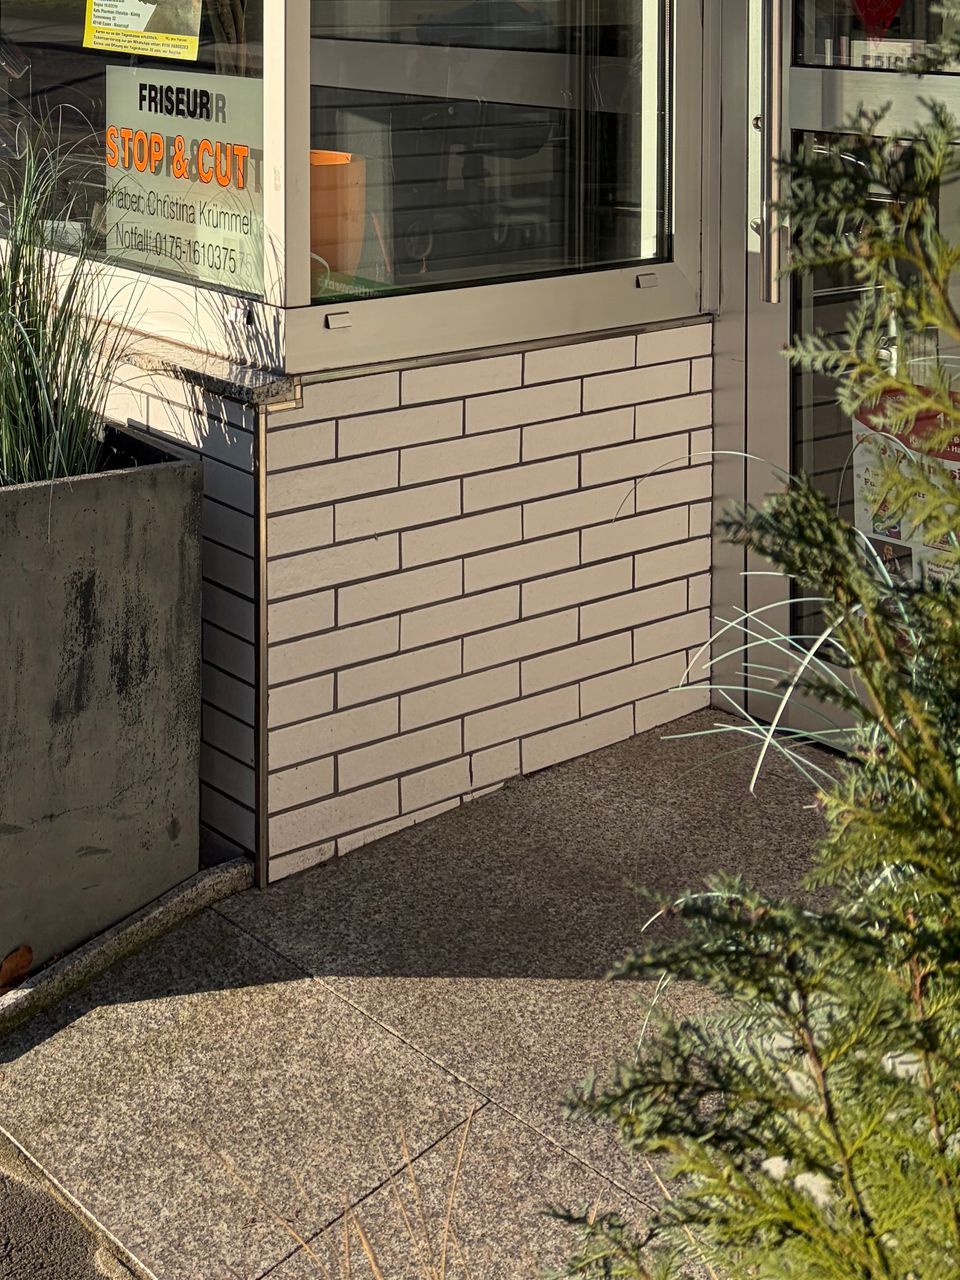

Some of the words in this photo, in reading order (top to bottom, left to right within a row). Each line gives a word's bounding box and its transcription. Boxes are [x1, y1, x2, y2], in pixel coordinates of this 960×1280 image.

[139, 83, 210, 120] FRISEUR
[106, 125, 164, 174] STOP
[173, 135, 189, 179] &
[198, 138, 249, 190] CUT
[147, 190, 196, 225] Christina
[199, 199, 253, 236] Krümmel
[154, 231, 237, 274] 0175-1610375
